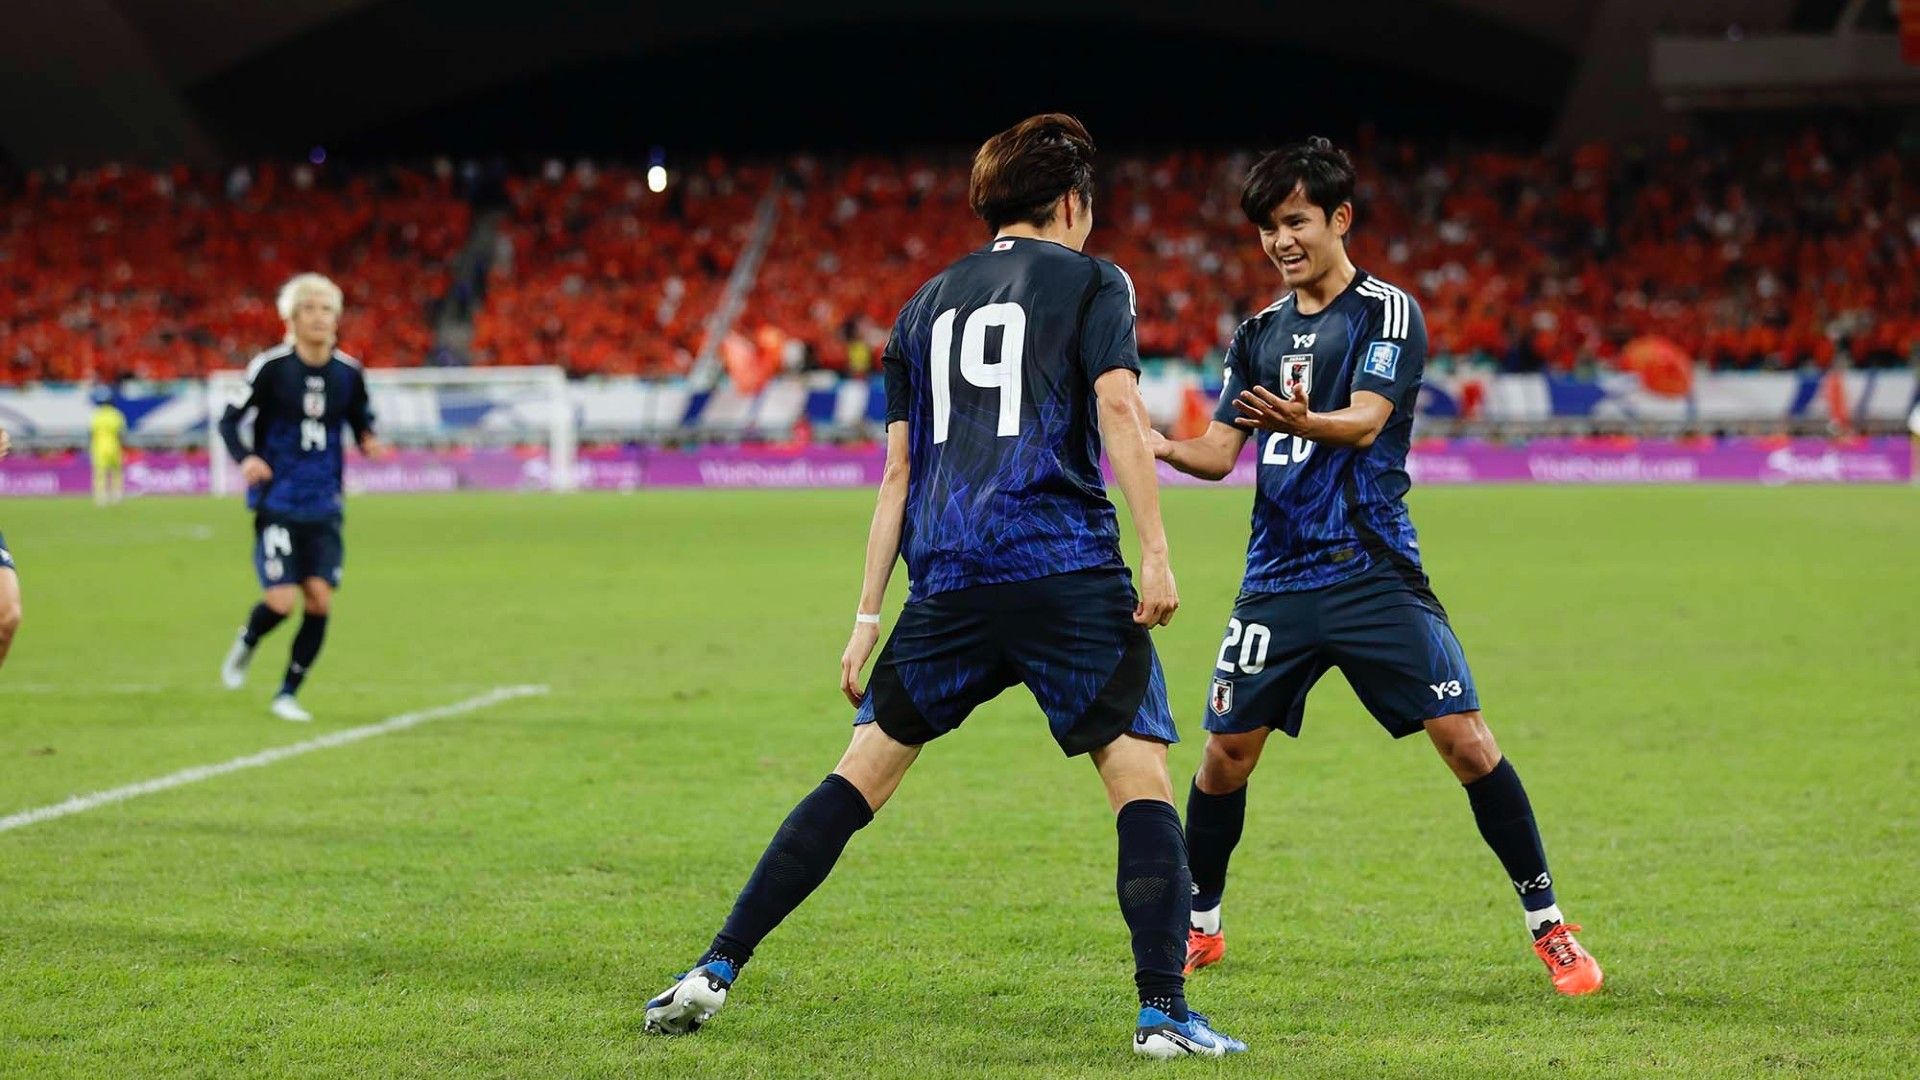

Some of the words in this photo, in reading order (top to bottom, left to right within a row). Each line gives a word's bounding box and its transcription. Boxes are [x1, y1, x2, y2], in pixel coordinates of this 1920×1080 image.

[1292, 333, 1316, 349] Y-3
[931, 302, 1026, 444] 19
[1262, 432, 1316, 465] 20
[1216, 617, 1271, 675] 20
[1430, 680, 1462, 700] Y-3
[1513, 871, 1551, 894] Y-3
